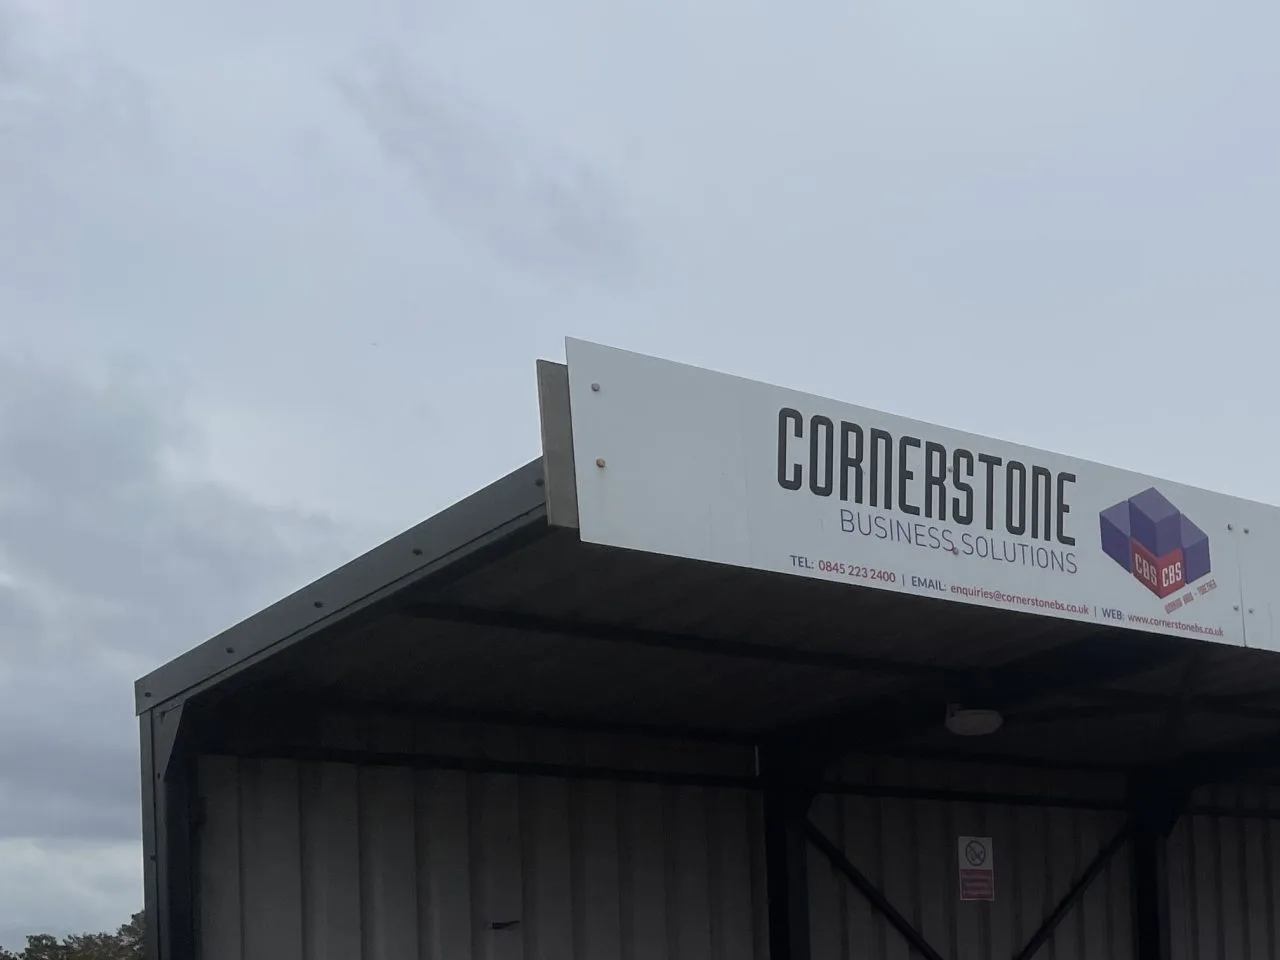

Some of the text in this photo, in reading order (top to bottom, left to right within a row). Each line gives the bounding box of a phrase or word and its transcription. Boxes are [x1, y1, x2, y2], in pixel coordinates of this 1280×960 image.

[777, 407, 1076, 546] CORNERSTONE
[840, 508, 1077, 574] BUSINESS SOLUTIONS
[1135, 553, 1157, 586] CBS
[790, 555, 1224, 637] TEL: 0845 223 2400 EMAIL: enquiries@cornerstonebs.co.uk WEB: www.cornerstonebs.co.uk
[1162, 562, 1182, 587] CBS
